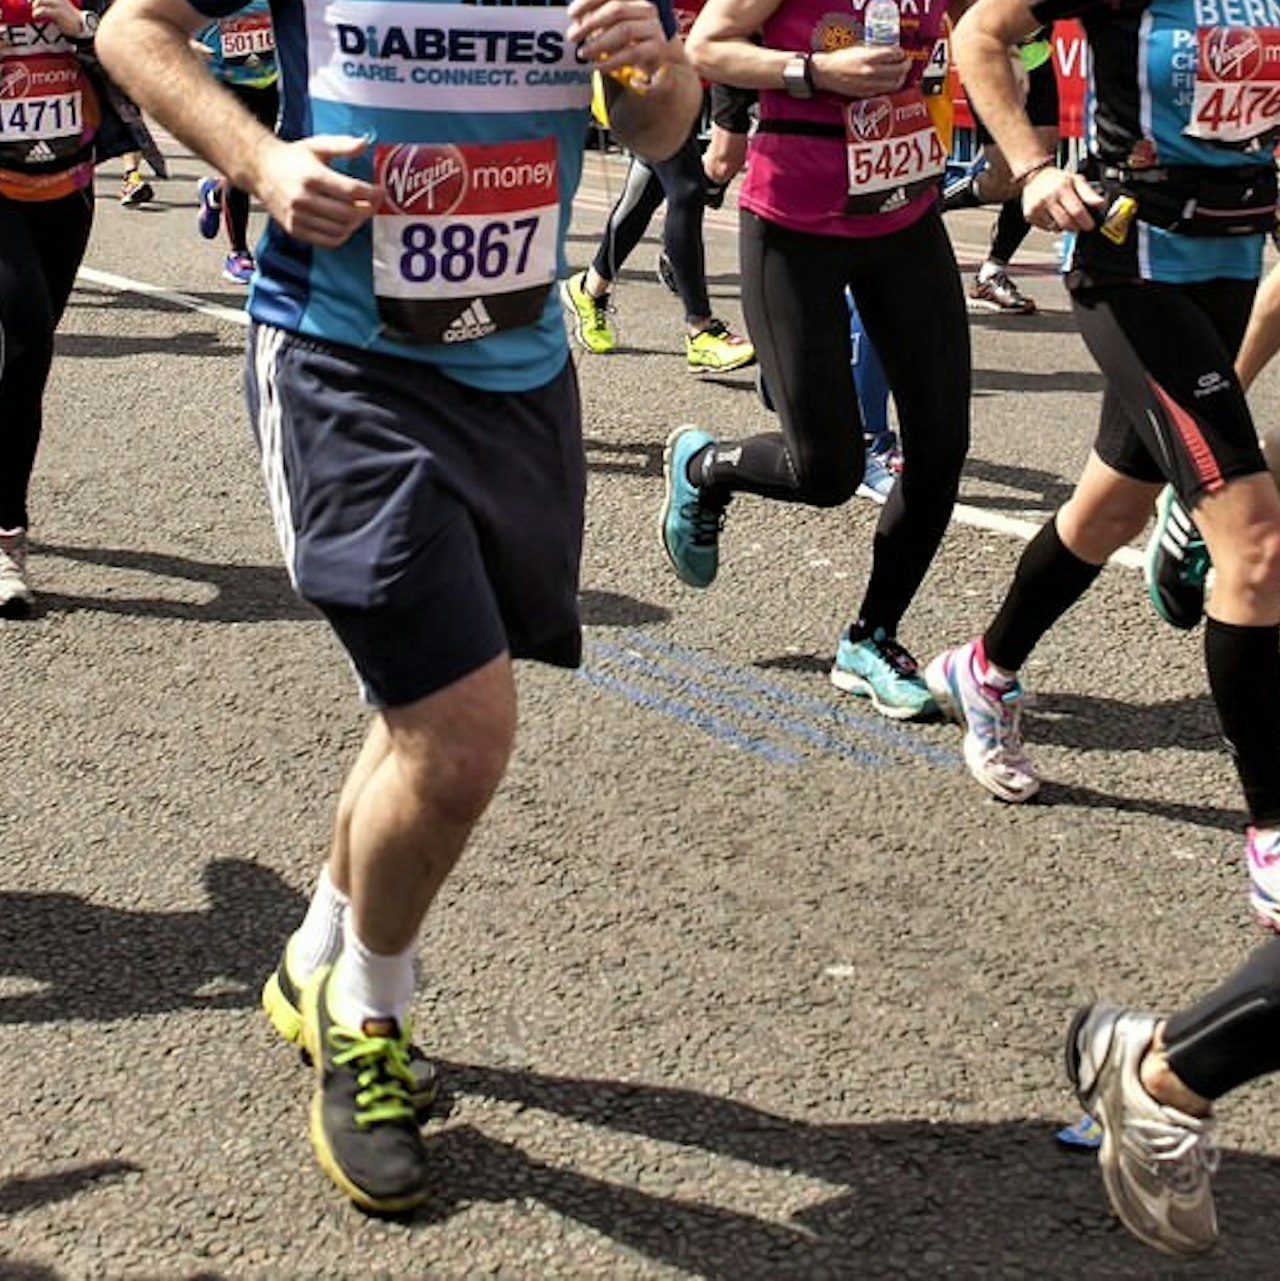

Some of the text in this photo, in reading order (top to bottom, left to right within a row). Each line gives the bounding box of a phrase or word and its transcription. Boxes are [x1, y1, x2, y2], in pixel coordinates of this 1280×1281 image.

[342, 61, 404, 84] CARE.
[411, 66, 518, 87] CONNECT.
[387, 144, 557, 210] Virgin money
[853, 131, 945, 184] 54214
[399, 216, 541, 283] 8867
